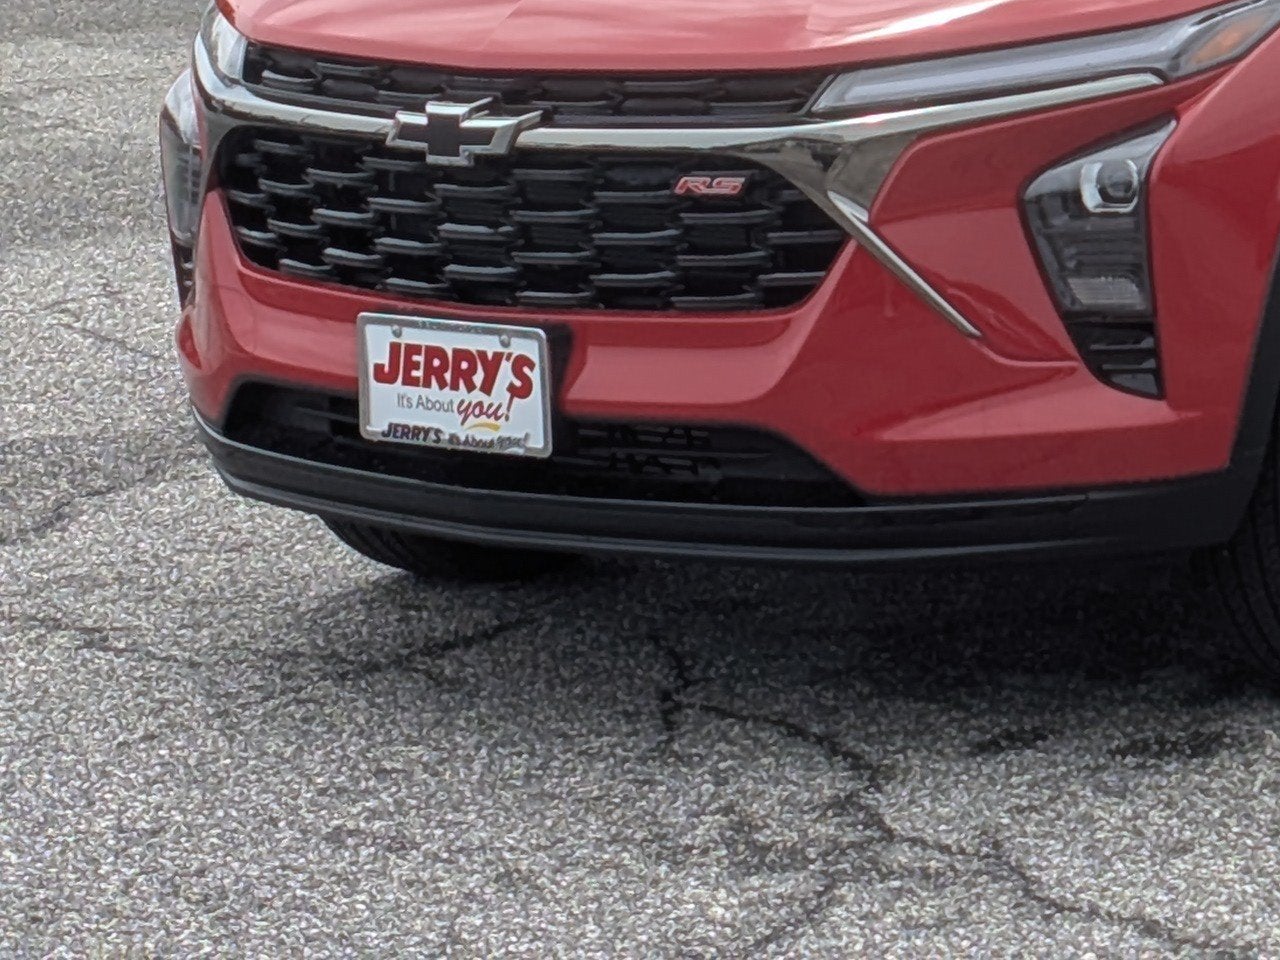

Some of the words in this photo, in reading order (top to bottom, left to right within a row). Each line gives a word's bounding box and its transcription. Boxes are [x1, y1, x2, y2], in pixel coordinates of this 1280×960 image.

[674, 176, 746, 195] RS
[373, 341, 536, 400] JERRY'S
[397, 393, 413, 409] It's
[416, 394, 454, 412] About
[456, 393, 515, 427] you!
[381, 422, 444, 444] JERRY'S
